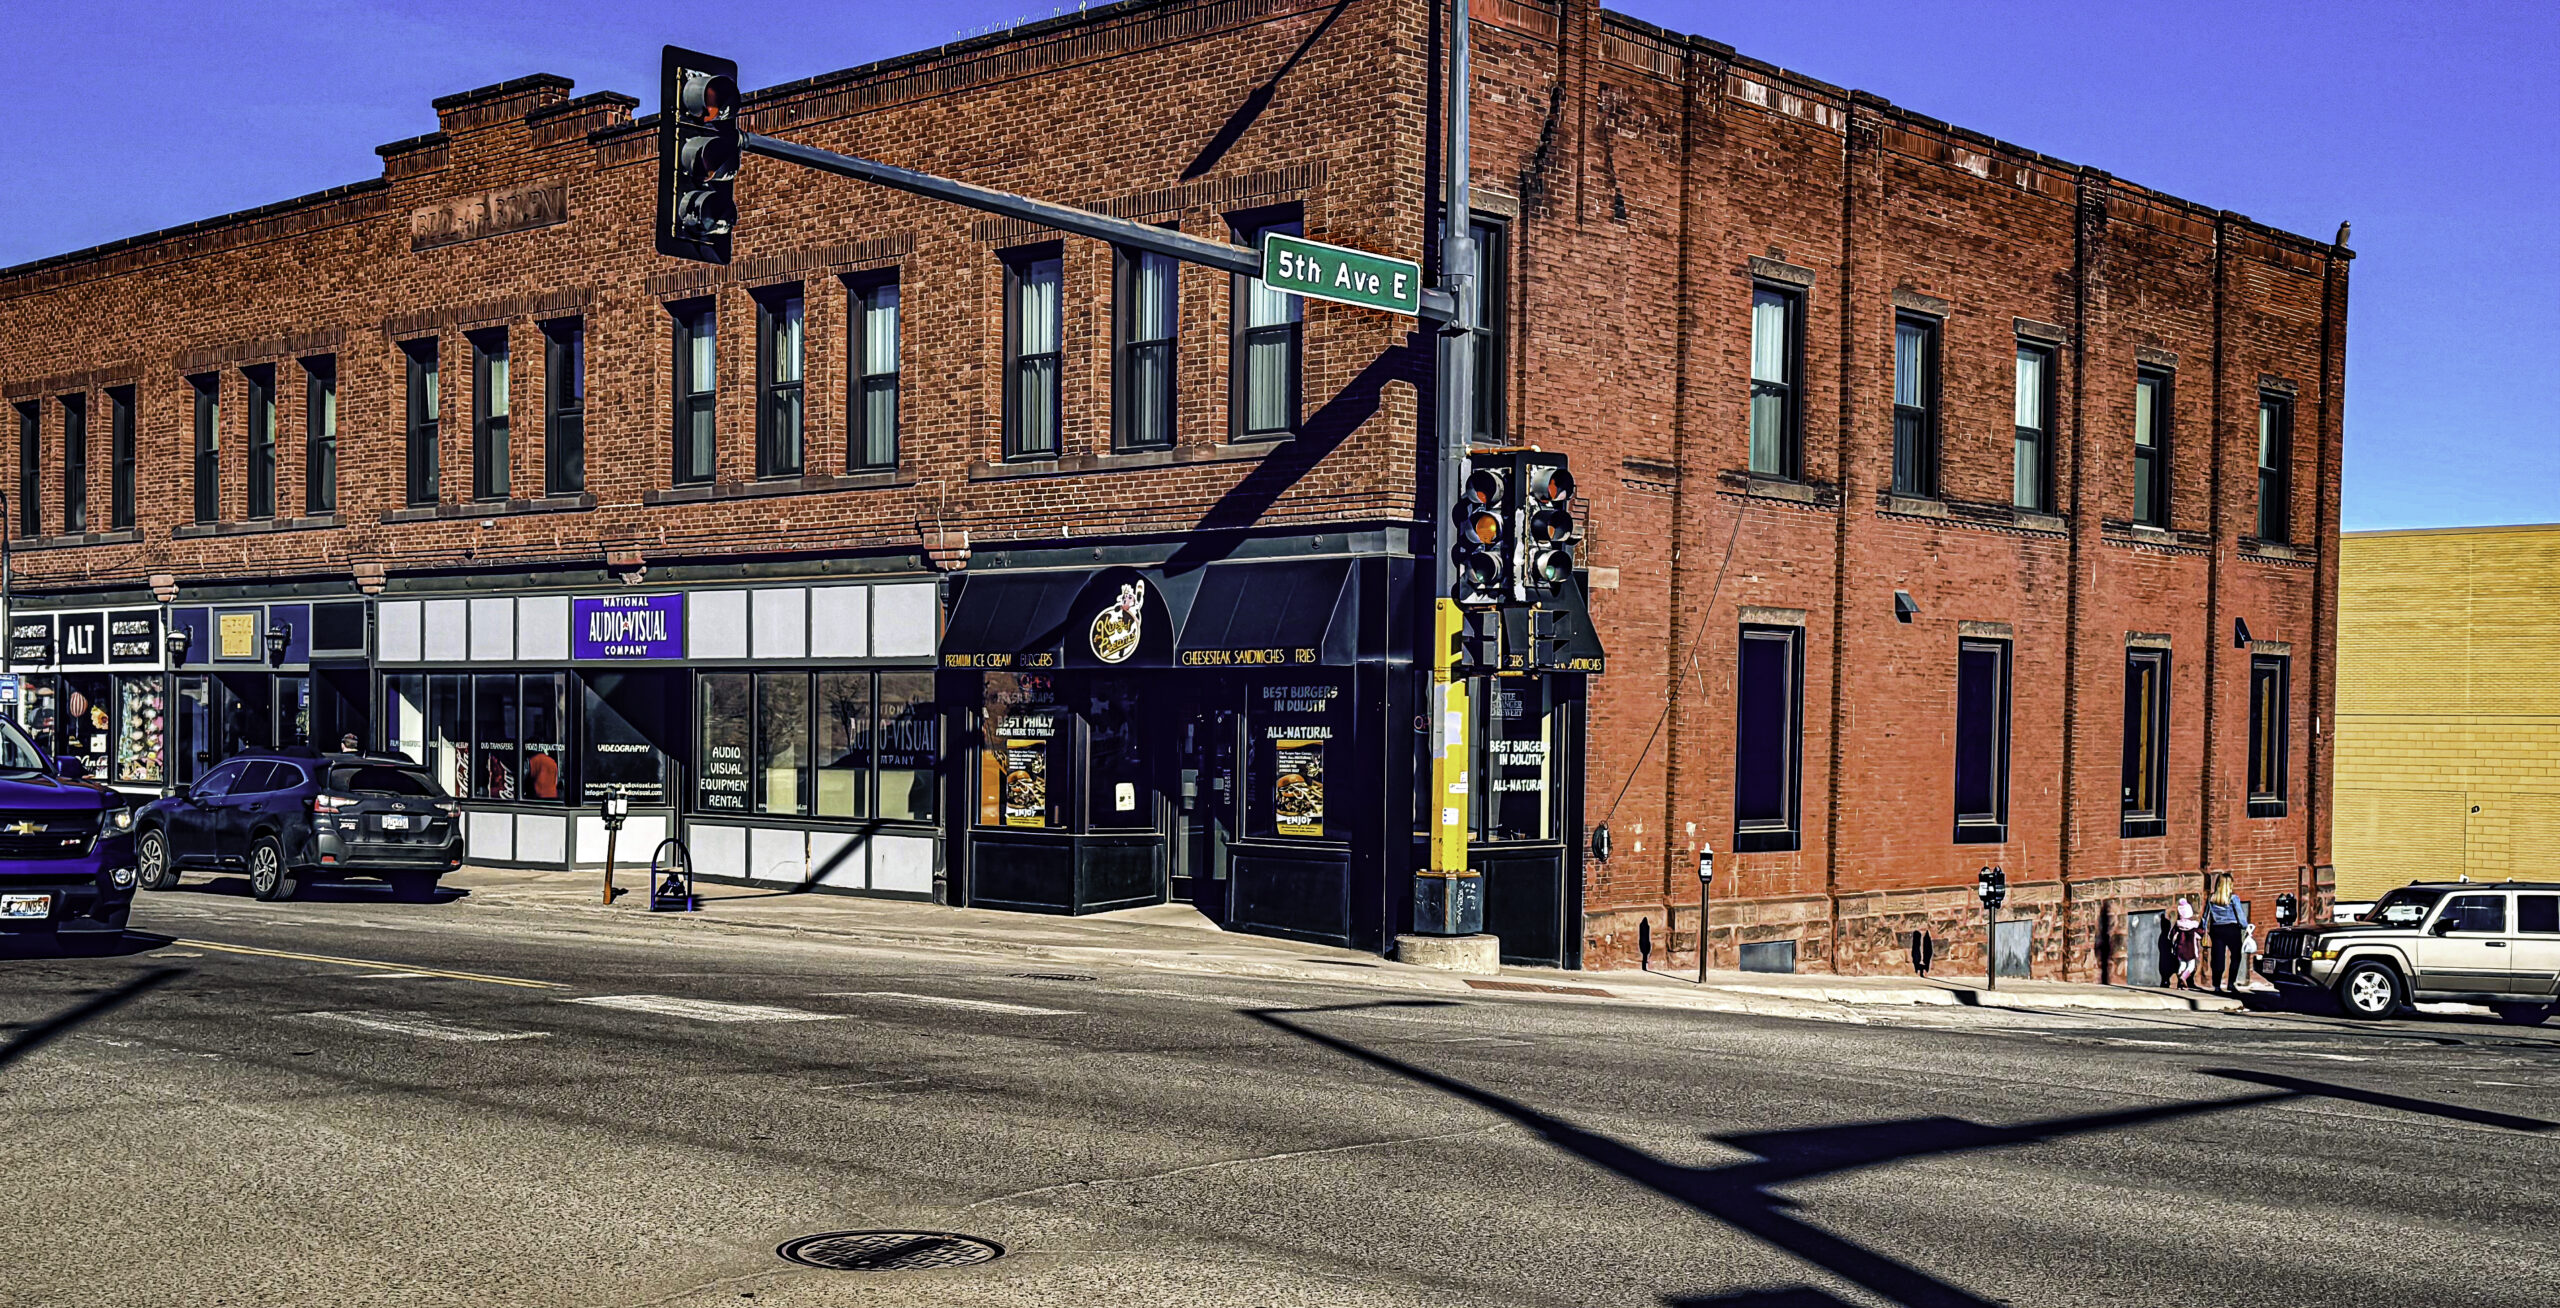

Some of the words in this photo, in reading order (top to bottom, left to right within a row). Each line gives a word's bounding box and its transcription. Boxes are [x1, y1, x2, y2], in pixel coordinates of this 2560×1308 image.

[1279, 251, 1321, 283] 5th
[1334, 262, 1380, 294] Ave
[1393, 272, 1407, 299] E
[603, 597, 648, 608] NATIONAL
[67, 624, 95, 655] ALT
[604, 645, 647, 656] COMPANY
[1182, 650, 1231, 665] CHEESESTEAK
[1234, 648, 1285, 664] SANDWICHES
[1295, 648, 1316, 663] FRIES
[945, 654, 971, 667] PREMIUM
[973, 653, 985, 667] ICE
[987, 653, 1011, 667] CREAM
[1263, 686, 1288, 699] BEST
[1290, 685, 1338, 699] BURGERS
[1274, 699, 1285, 712] IN
[1287, 699, 1326, 712] DULUTH
[998, 715, 1020, 728] BEST
[1023, 715, 1054, 728] PHILLY
[1027, 728, 1035, 736] TO
[1266, 726, 1333, 739] ALL-NATURAL
[597, 744, 651, 753] VIDEOGRAPHY
[712, 746, 741, 759] AUDIO
[1490, 740, 1511, 753] BEST
[1499, 753, 1508, 766] IN
[1510, 753, 1542, 766] DULUTH
[710, 762, 743, 775] VISUAL
[700, 778, 749, 792] EQUIPMEN
[709, 794, 744, 808] RENTAL
[1286, 816, 1312, 826] ENJOY
